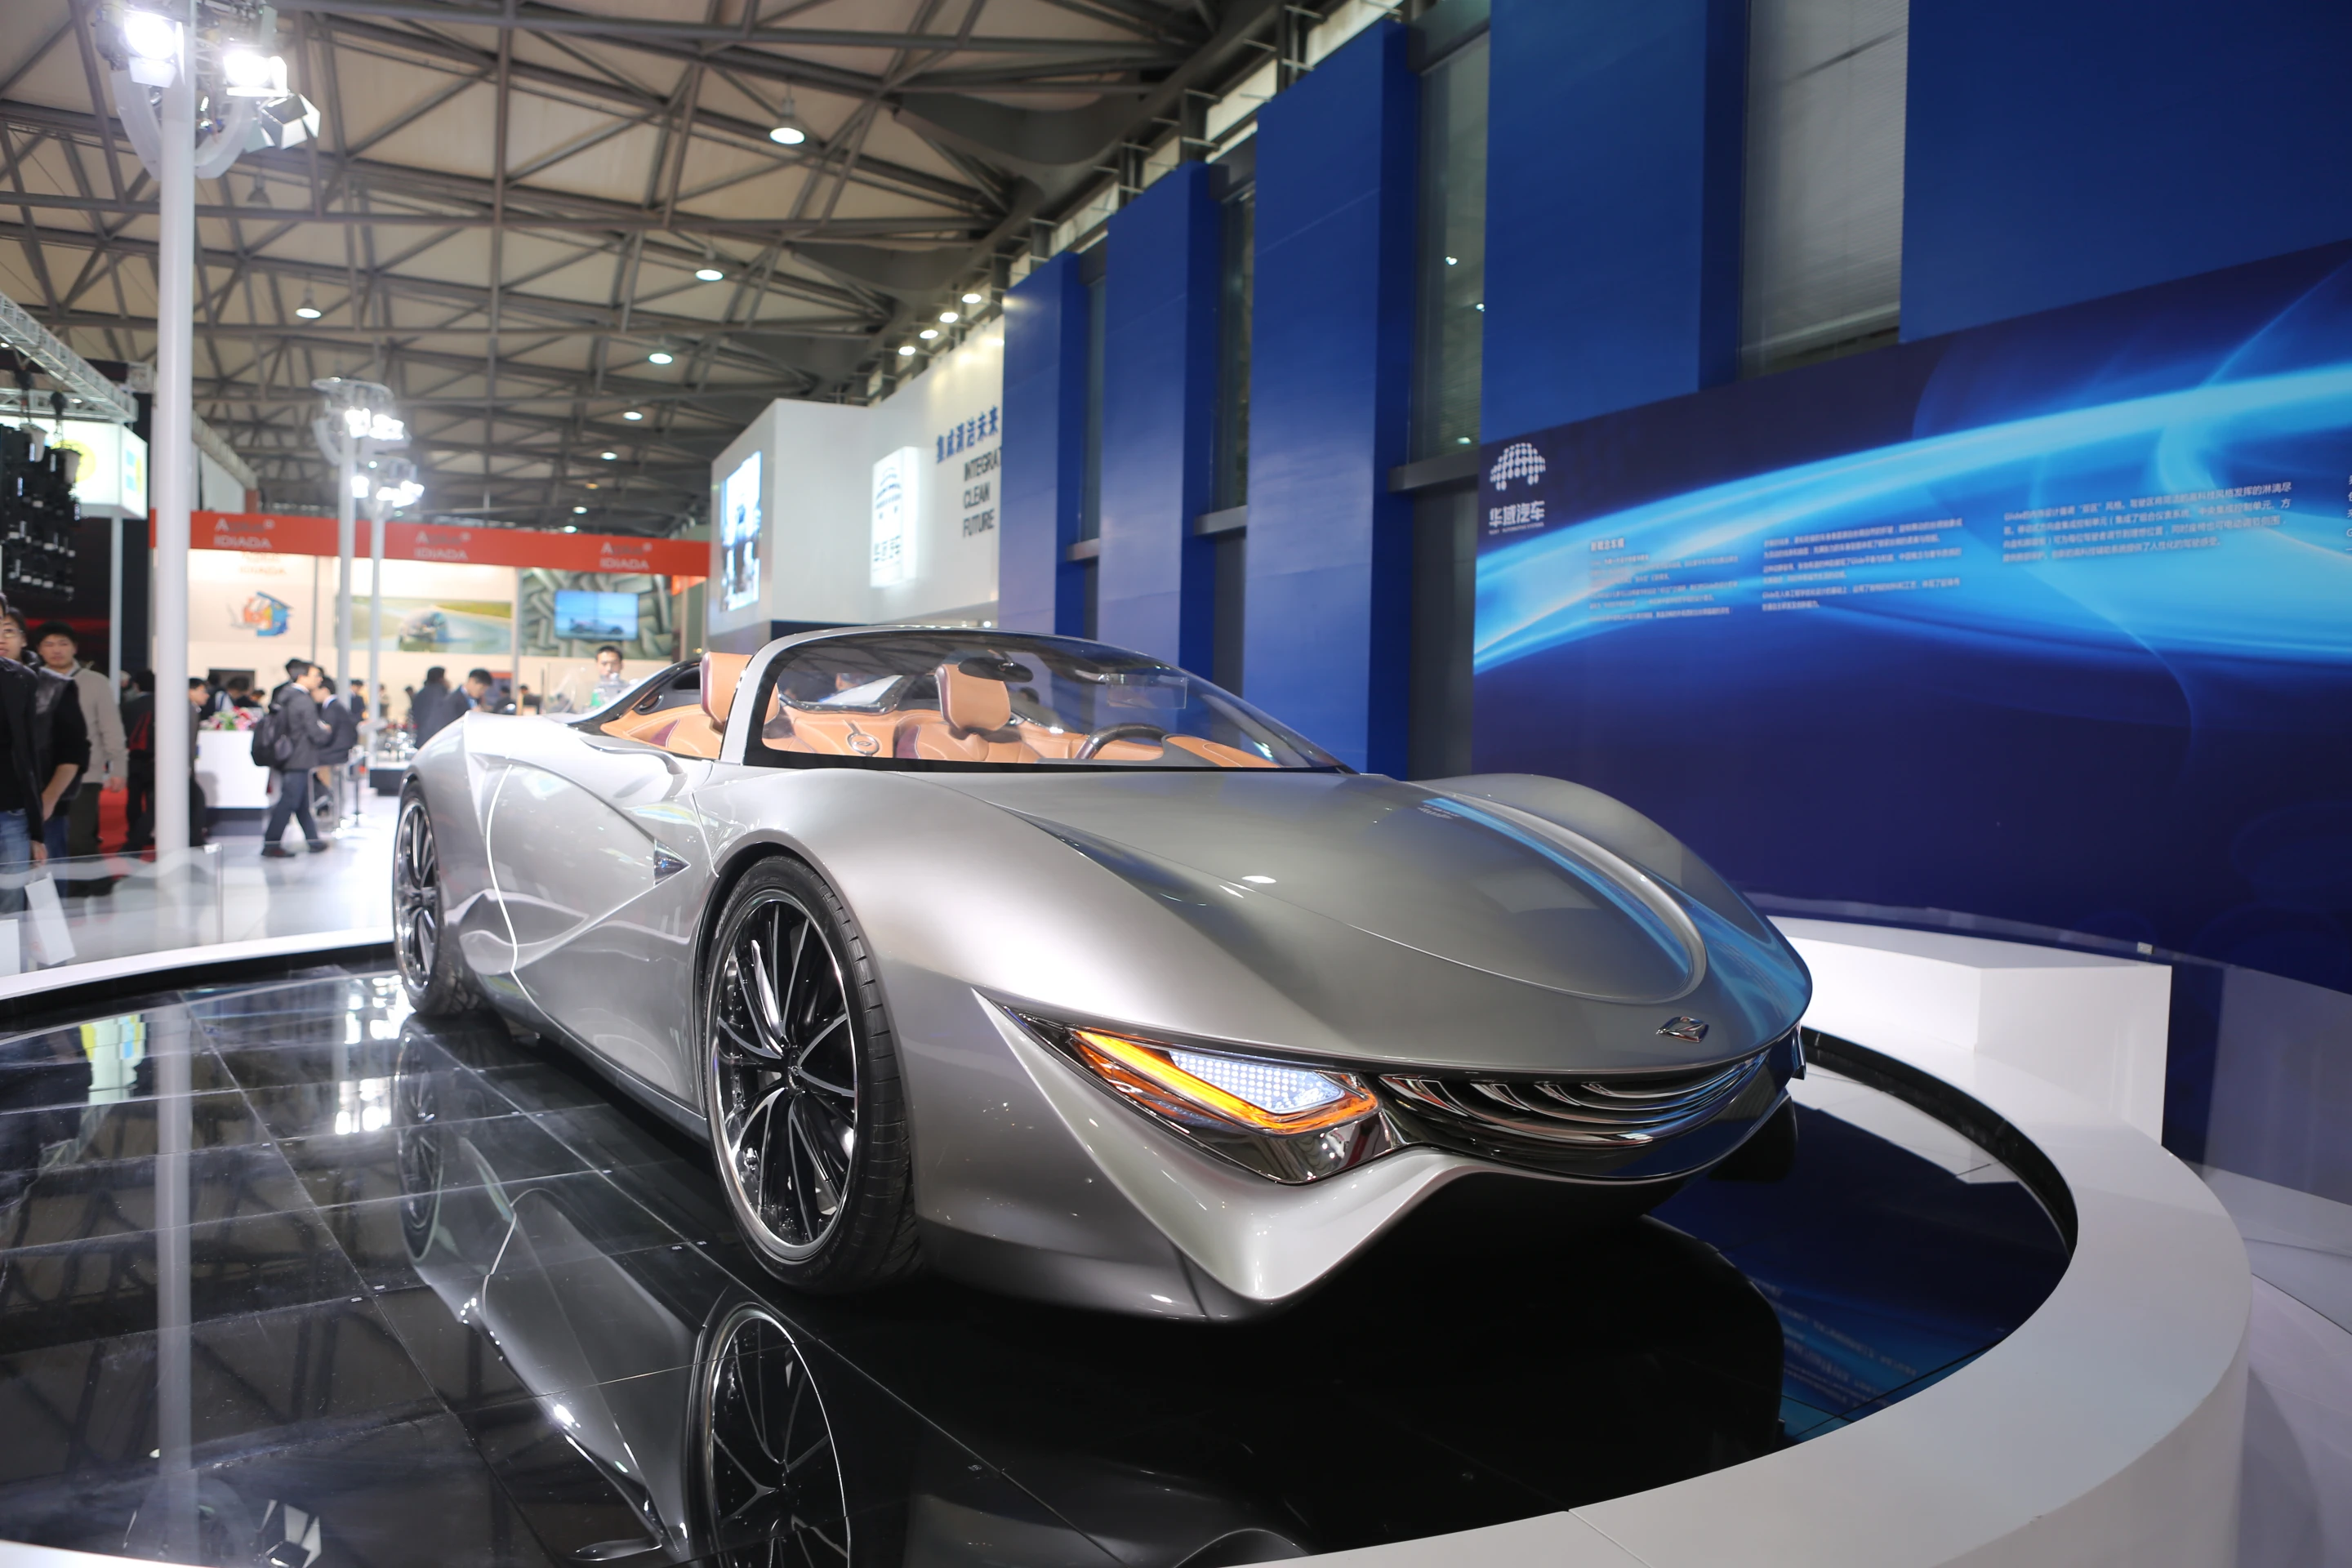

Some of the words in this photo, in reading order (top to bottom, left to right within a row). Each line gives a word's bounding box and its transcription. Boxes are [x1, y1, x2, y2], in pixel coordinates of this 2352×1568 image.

[964, 481, 991, 509] CLEAN
[962, 508, 995, 539] FUTURE
[1489, 500, 1545, 528] 华域汽车
[214, 534, 273, 549] IDIADA
